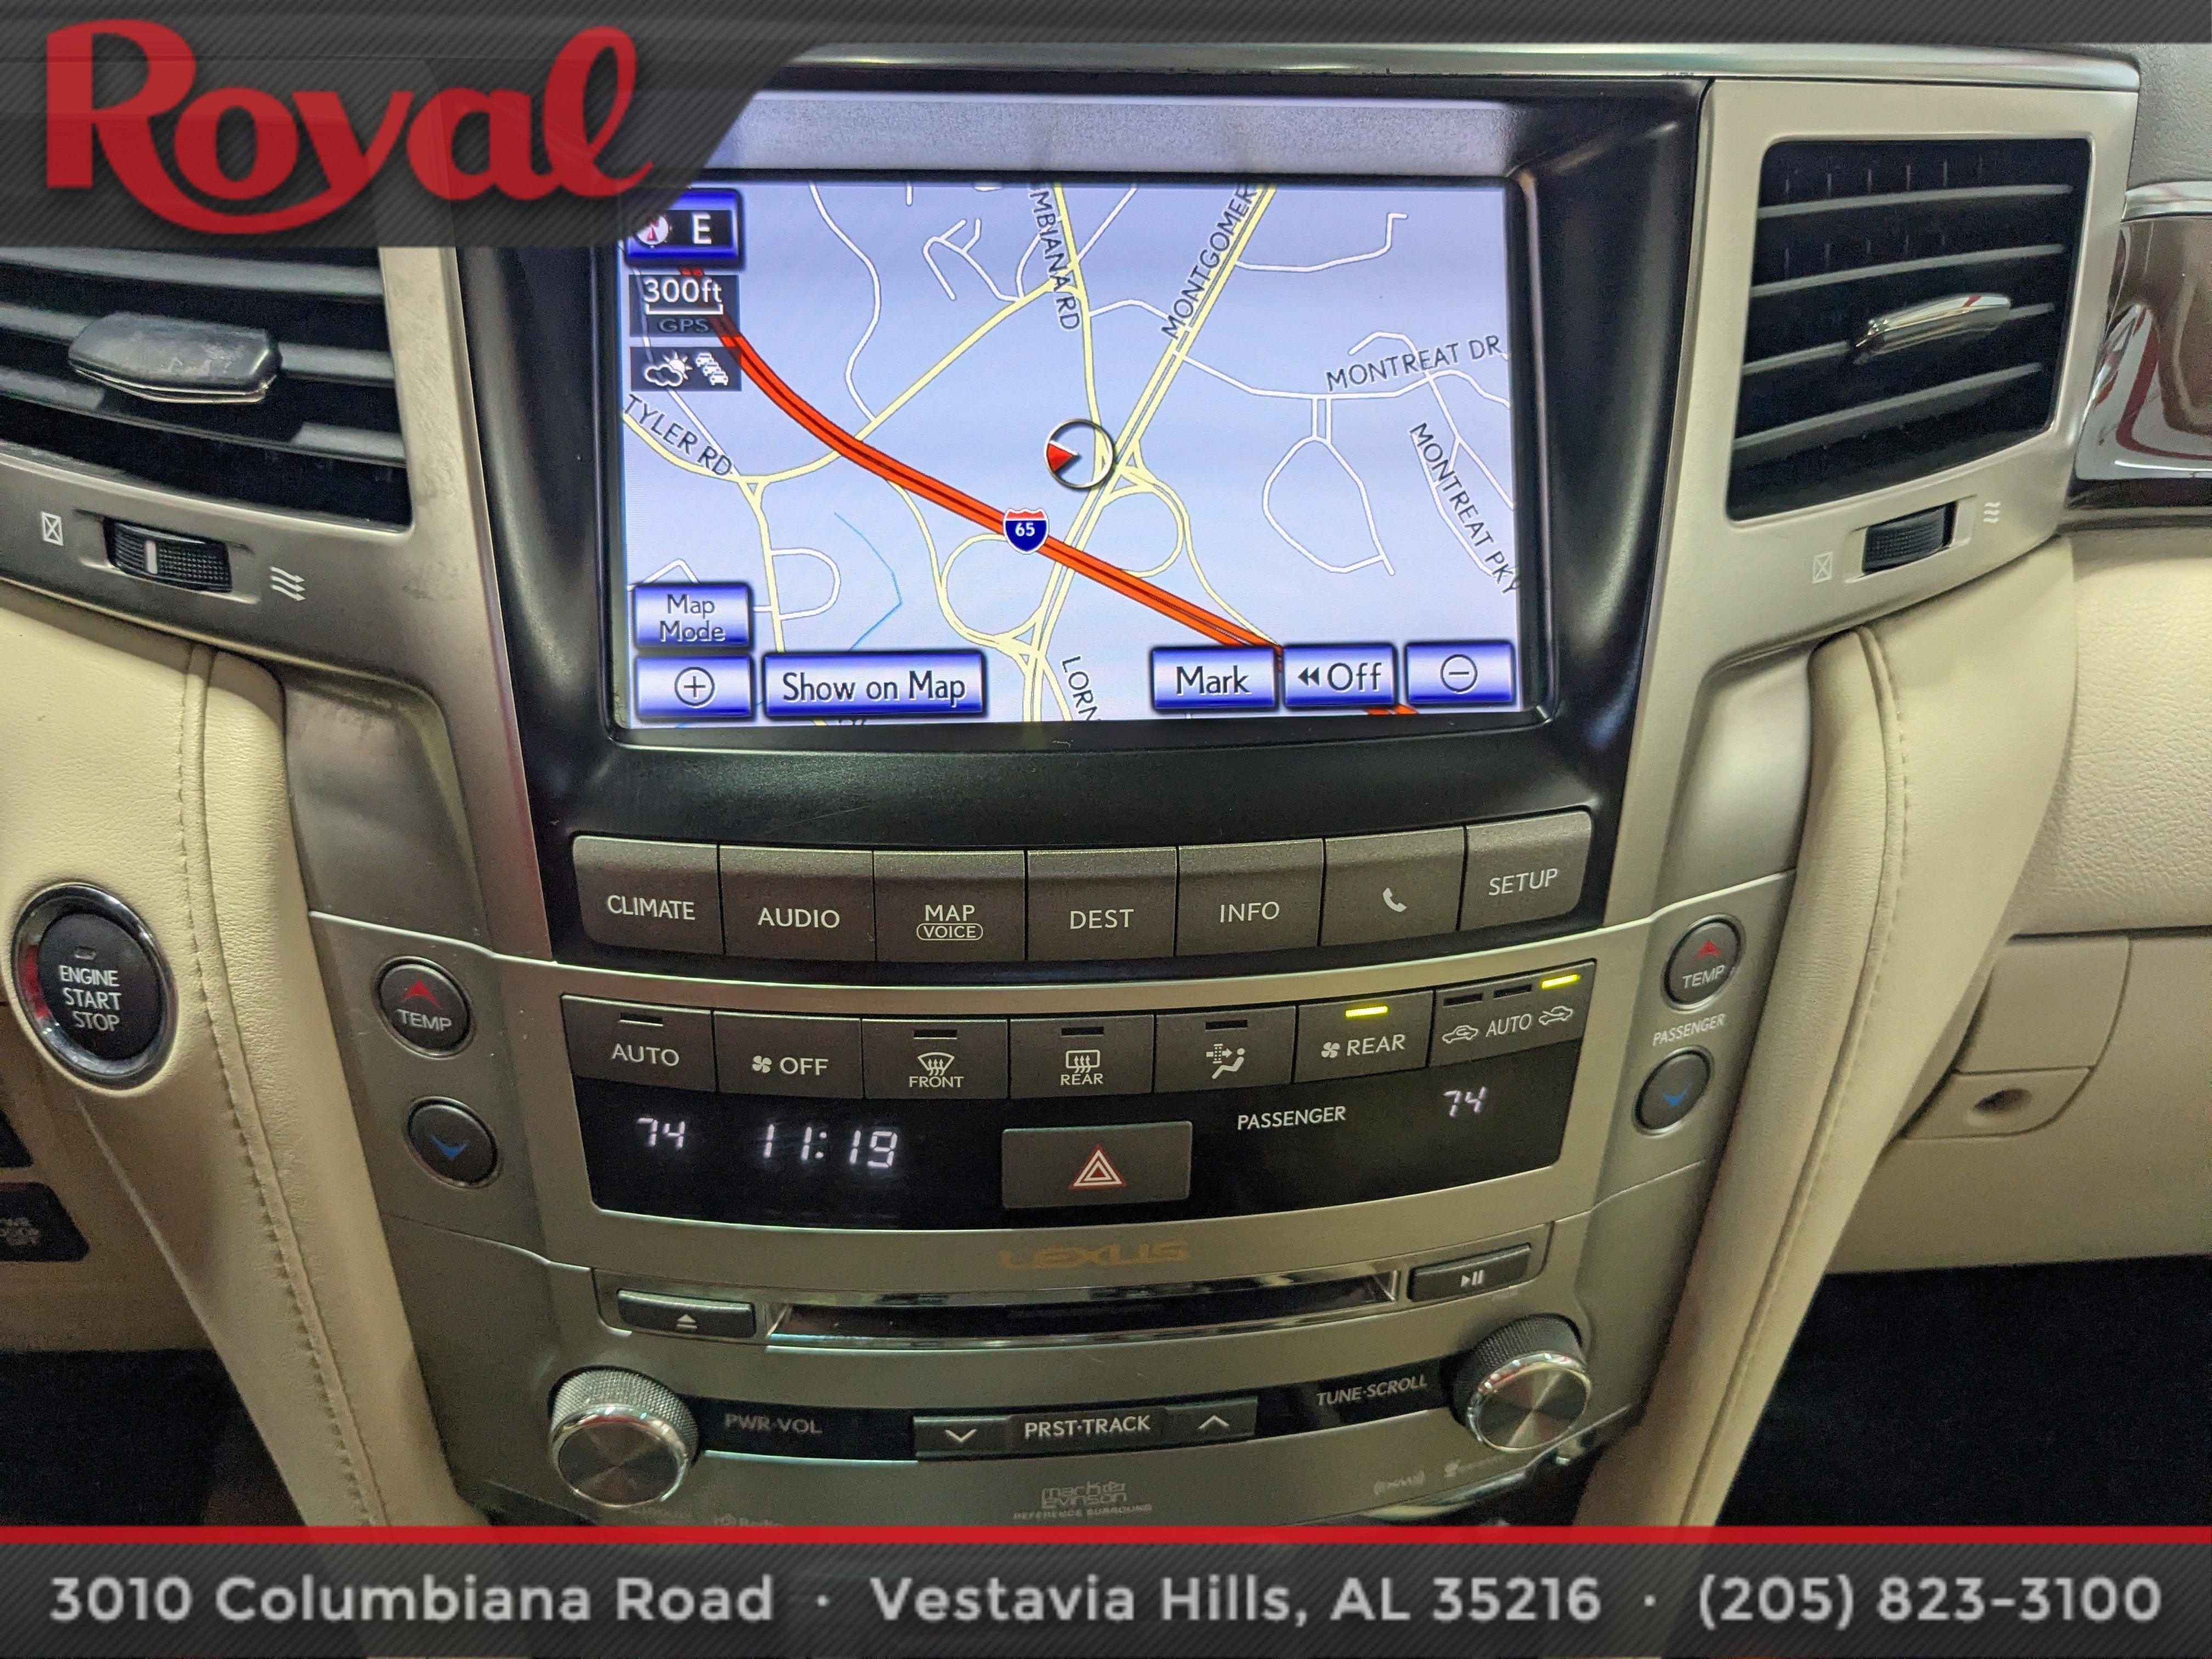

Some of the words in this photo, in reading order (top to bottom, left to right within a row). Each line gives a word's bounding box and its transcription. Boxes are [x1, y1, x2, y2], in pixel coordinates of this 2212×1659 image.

[693, 213, 712, 244] E
[1030, 184, 1070, 292] MBIANA
[1056, 296, 1080, 329] RD
[644, 278, 722, 302] 300ft
[660, 318, 708, 332] GPS
[1326, 342, 1459, 391] MONTREAT
[1469, 335, 1500, 360] DR
[623, 394, 699, 454] TYLER
[697, 445, 733, 476] RD
[1408, 422, 1494, 548] MONTREAT
[1485, 551, 1519, 594] PKY
[1015, 522, 1036, 537] 65
[667, 594, 715, 618] Map
[660, 620, 725, 642] Mode
[783, 672, 856, 702] Show
[867, 678, 899, 701] on
[909, 670, 966, 706] Map
[1176, 665, 1250, 695] Mark
[1328, 662, 1383, 691] Off
[1488, 868, 1559, 897] SETUP
[607, 895, 696, 921] CLIMATE
[757, 907, 840, 928] AUDIO
[924, 905, 975, 922] MAP
[1070, 909, 1135, 929] DEST
[1220, 901, 1280, 923] INFO
[923, 926, 977, 939] VOICE
[59, 964, 120, 988] ENGINE
[1682, 964, 1725, 989] TEMP
[63, 988, 122, 1012] START
[72, 1010, 120, 1032] STOP
[396, 1008, 452, 1032] TEMP
[1485, 1013, 1532, 1038] AUTO
[1652, 1013, 1726, 1046] PASSENGER
[612, 1043, 680, 1067] AUTO
[1347, 1034, 1406, 1057] REAR
[780, 1057, 828, 1076] OFF
[909, 1075, 964, 1088] FRONT
[1060, 1074, 1103, 1086] REAR
[1443, 1086, 1487, 1118] 74
[1237, 1105, 1346, 1131] PASSENGER
[636, 1116, 686, 1149] 74
[763, 1123, 899, 1169] 11:19
[998, 1241, 1189, 1269] LEXUS
